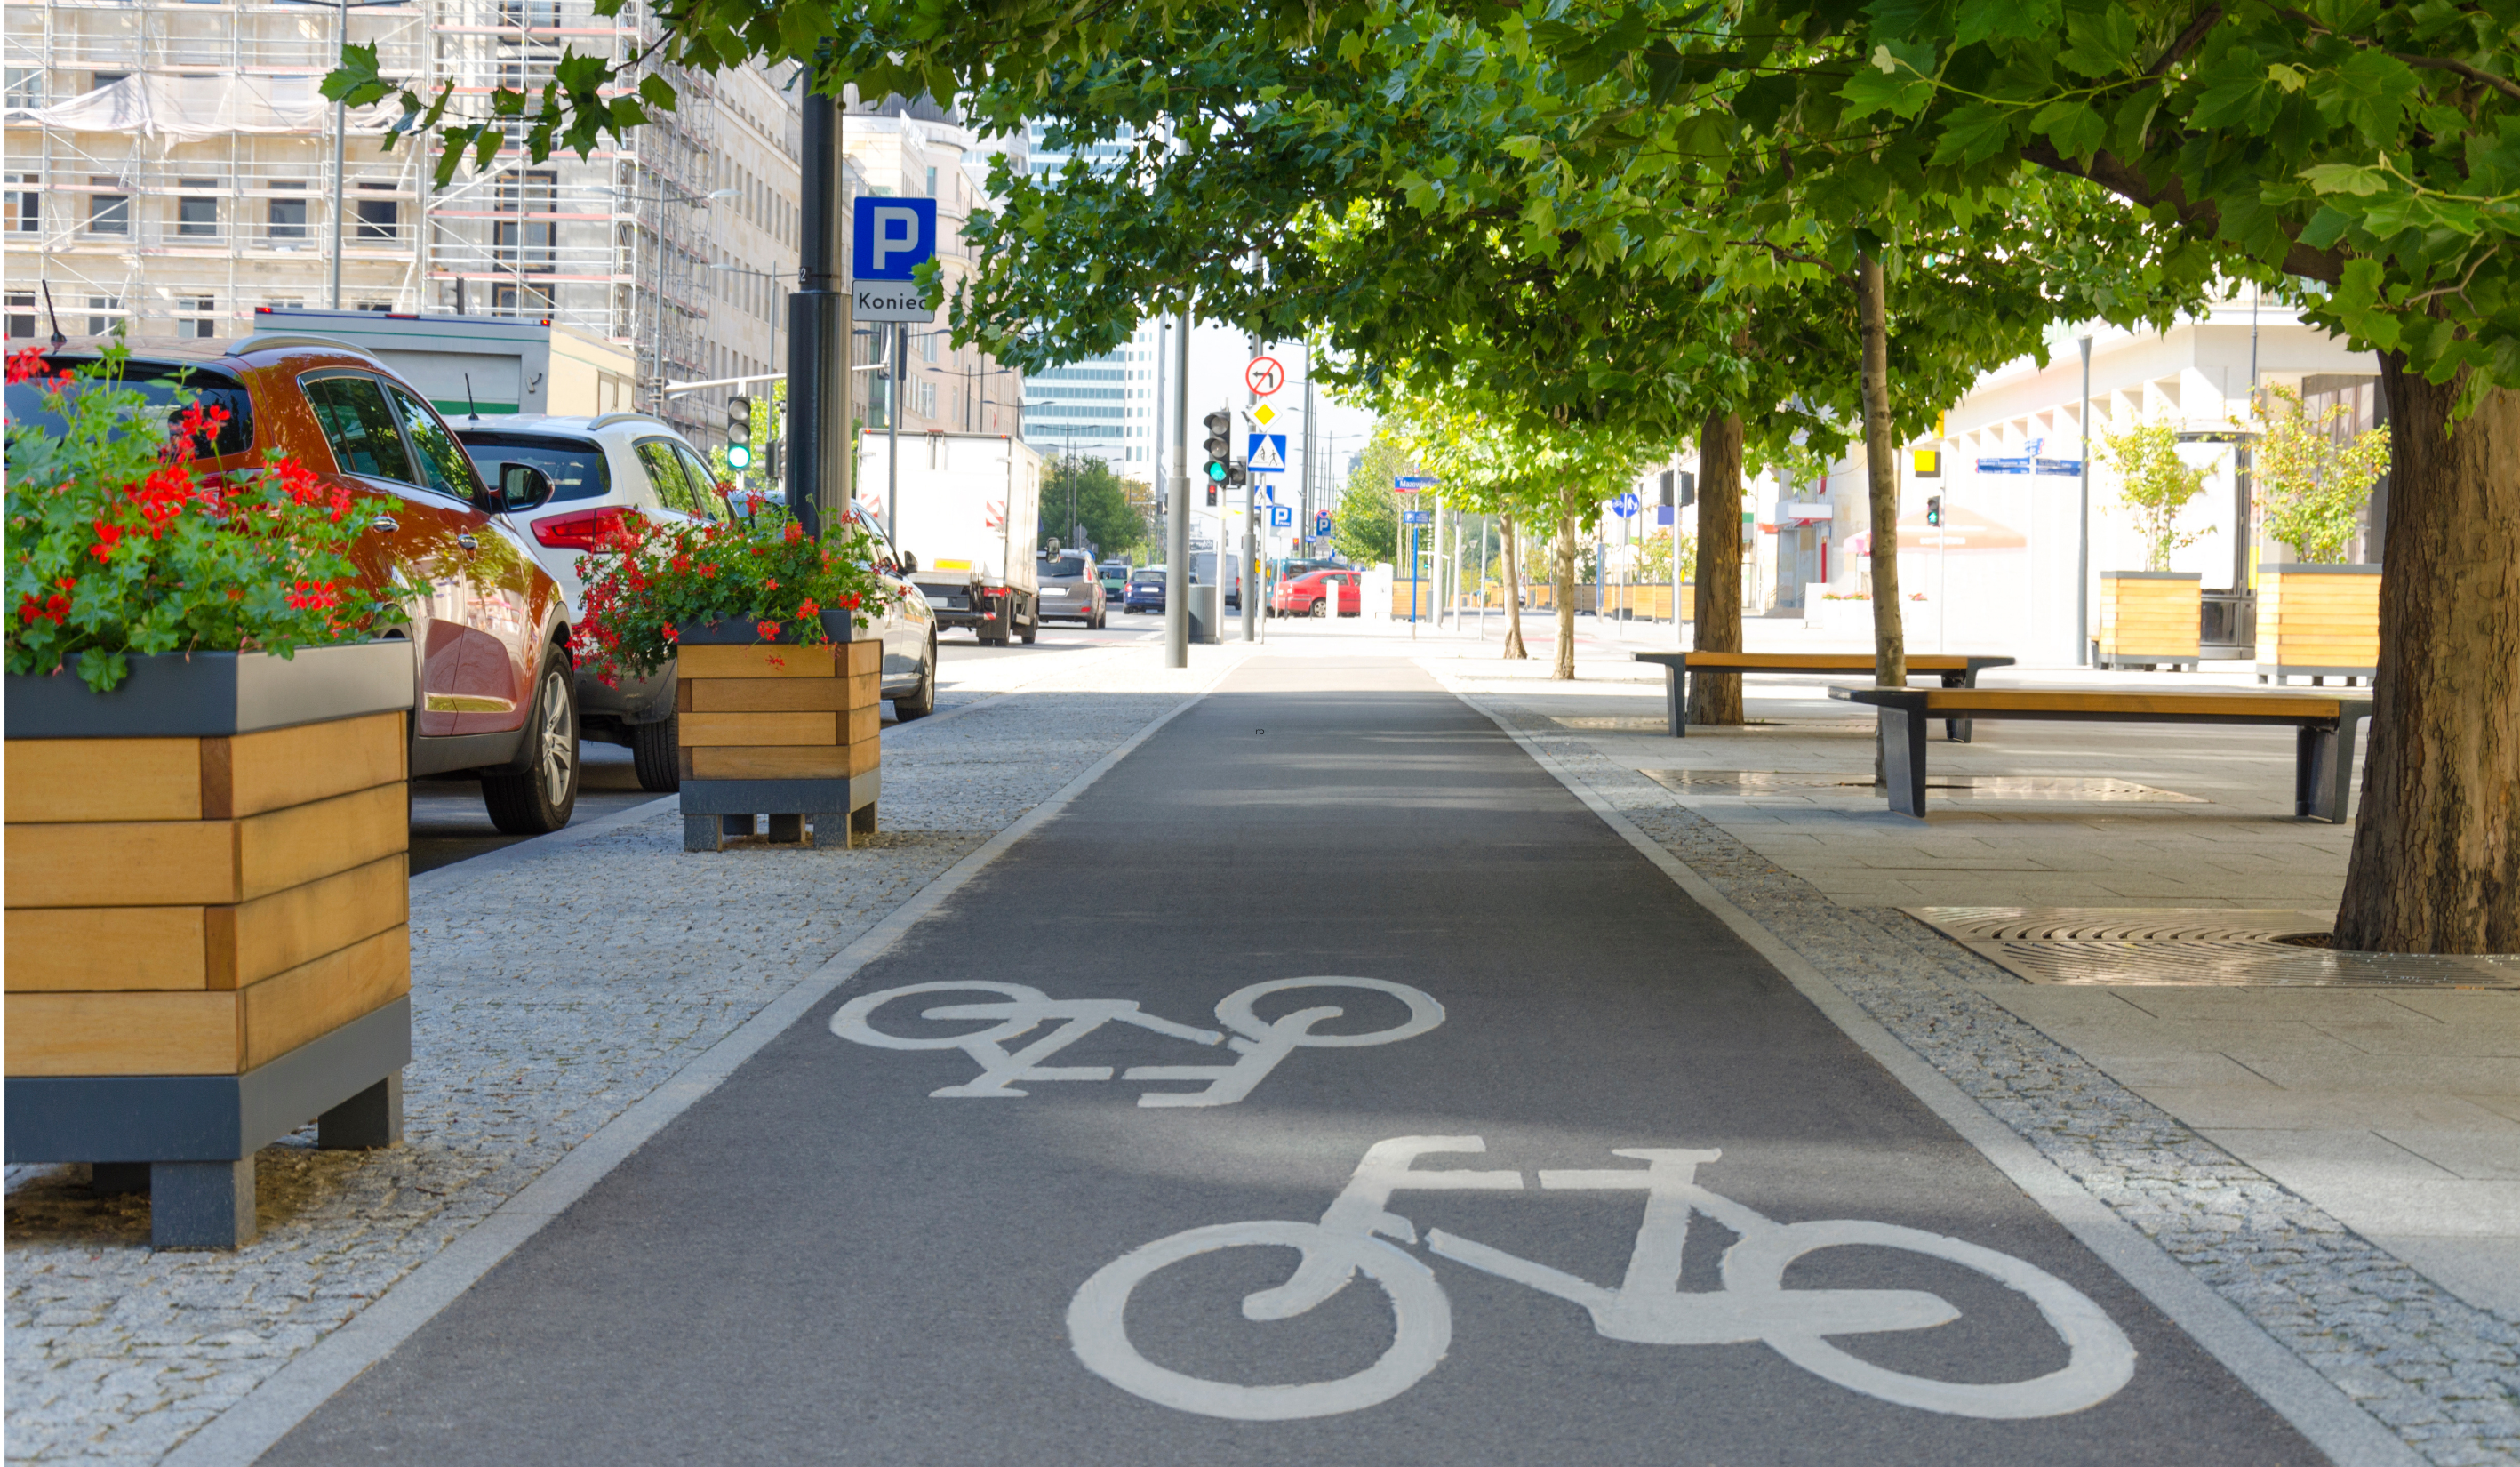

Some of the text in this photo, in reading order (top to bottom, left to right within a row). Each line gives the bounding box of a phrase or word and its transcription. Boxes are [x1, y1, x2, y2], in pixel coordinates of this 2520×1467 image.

[873, 206, 919, 270] P
[859, 292, 927, 310] Koniec
[1275, 508, 1289, 525] P
[1319, 519, 1329, 532] P
